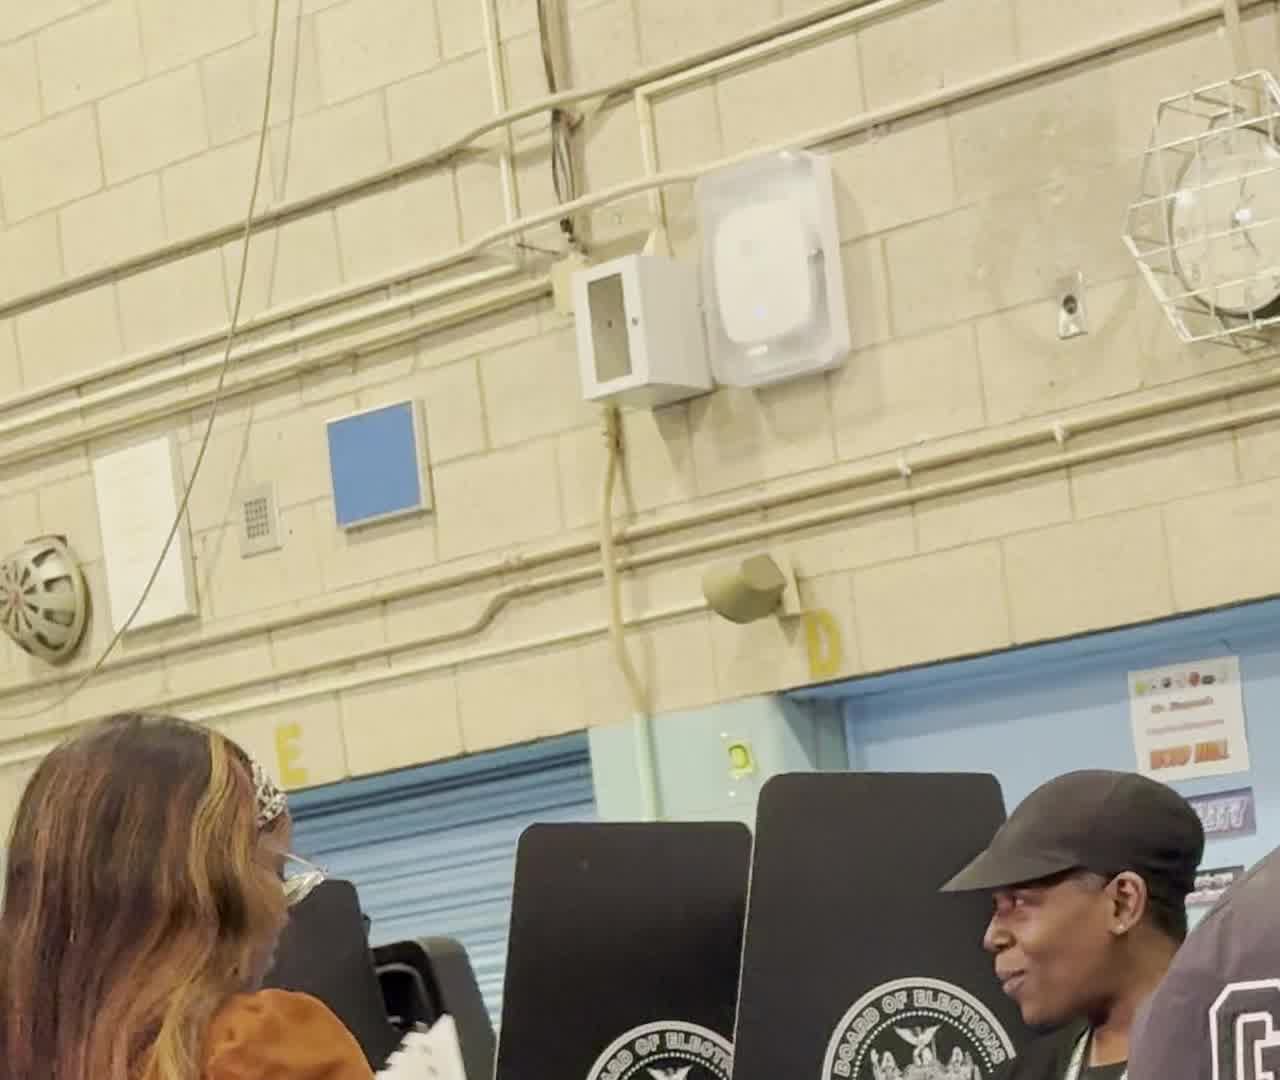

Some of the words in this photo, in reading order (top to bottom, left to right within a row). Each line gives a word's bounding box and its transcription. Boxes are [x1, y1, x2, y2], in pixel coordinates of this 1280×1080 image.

[805, 608, 842, 680] D
[274, 723, 308, 787] E
[634, 1033, 661, 1053] OF
[833, 1006, 881, 1078] BOARD
[882, 989, 908, 1014] OF
[912, 988, 1007, 1065] ELECTIONS
